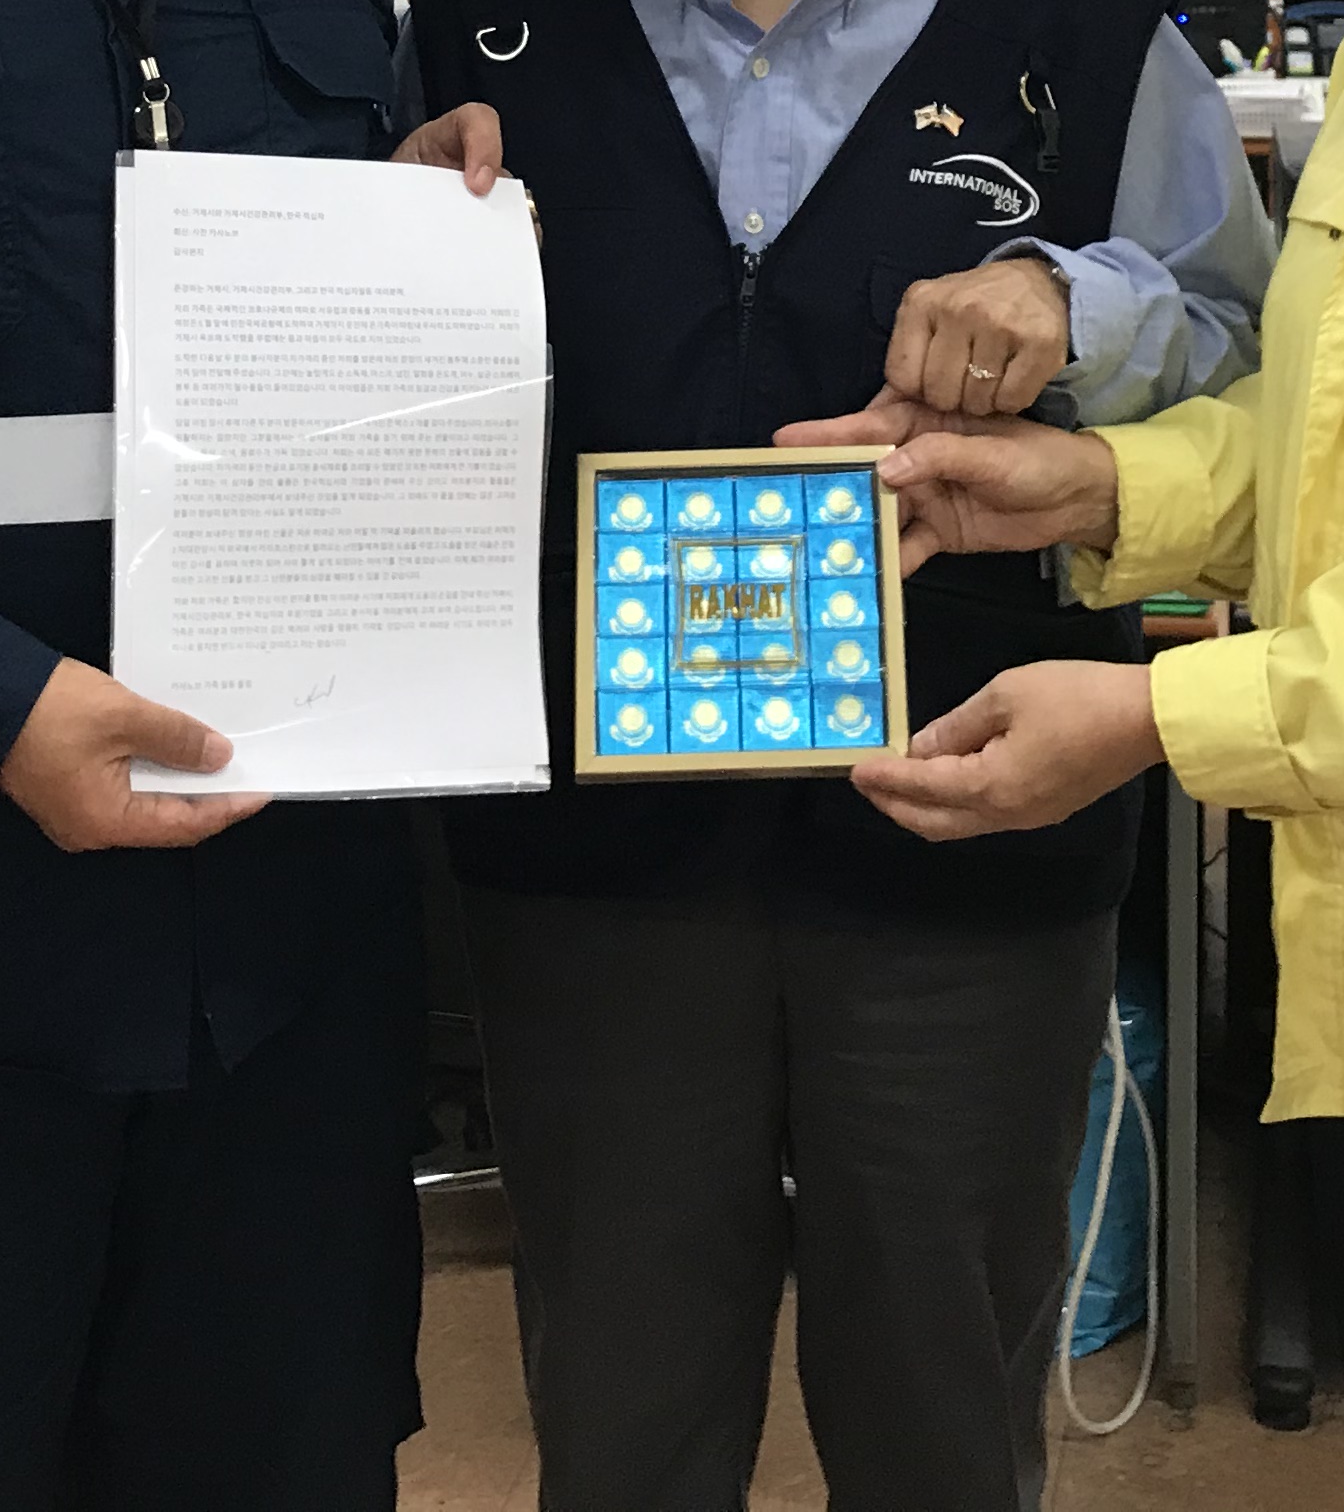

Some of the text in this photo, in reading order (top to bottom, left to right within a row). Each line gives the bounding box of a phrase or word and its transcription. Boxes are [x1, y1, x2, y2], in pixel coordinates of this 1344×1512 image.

[909, 167, 1022, 204] INTERNATIONAL
[994, 198, 1021, 214] SOS
[689, 582, 788, 621] RAKHAT
